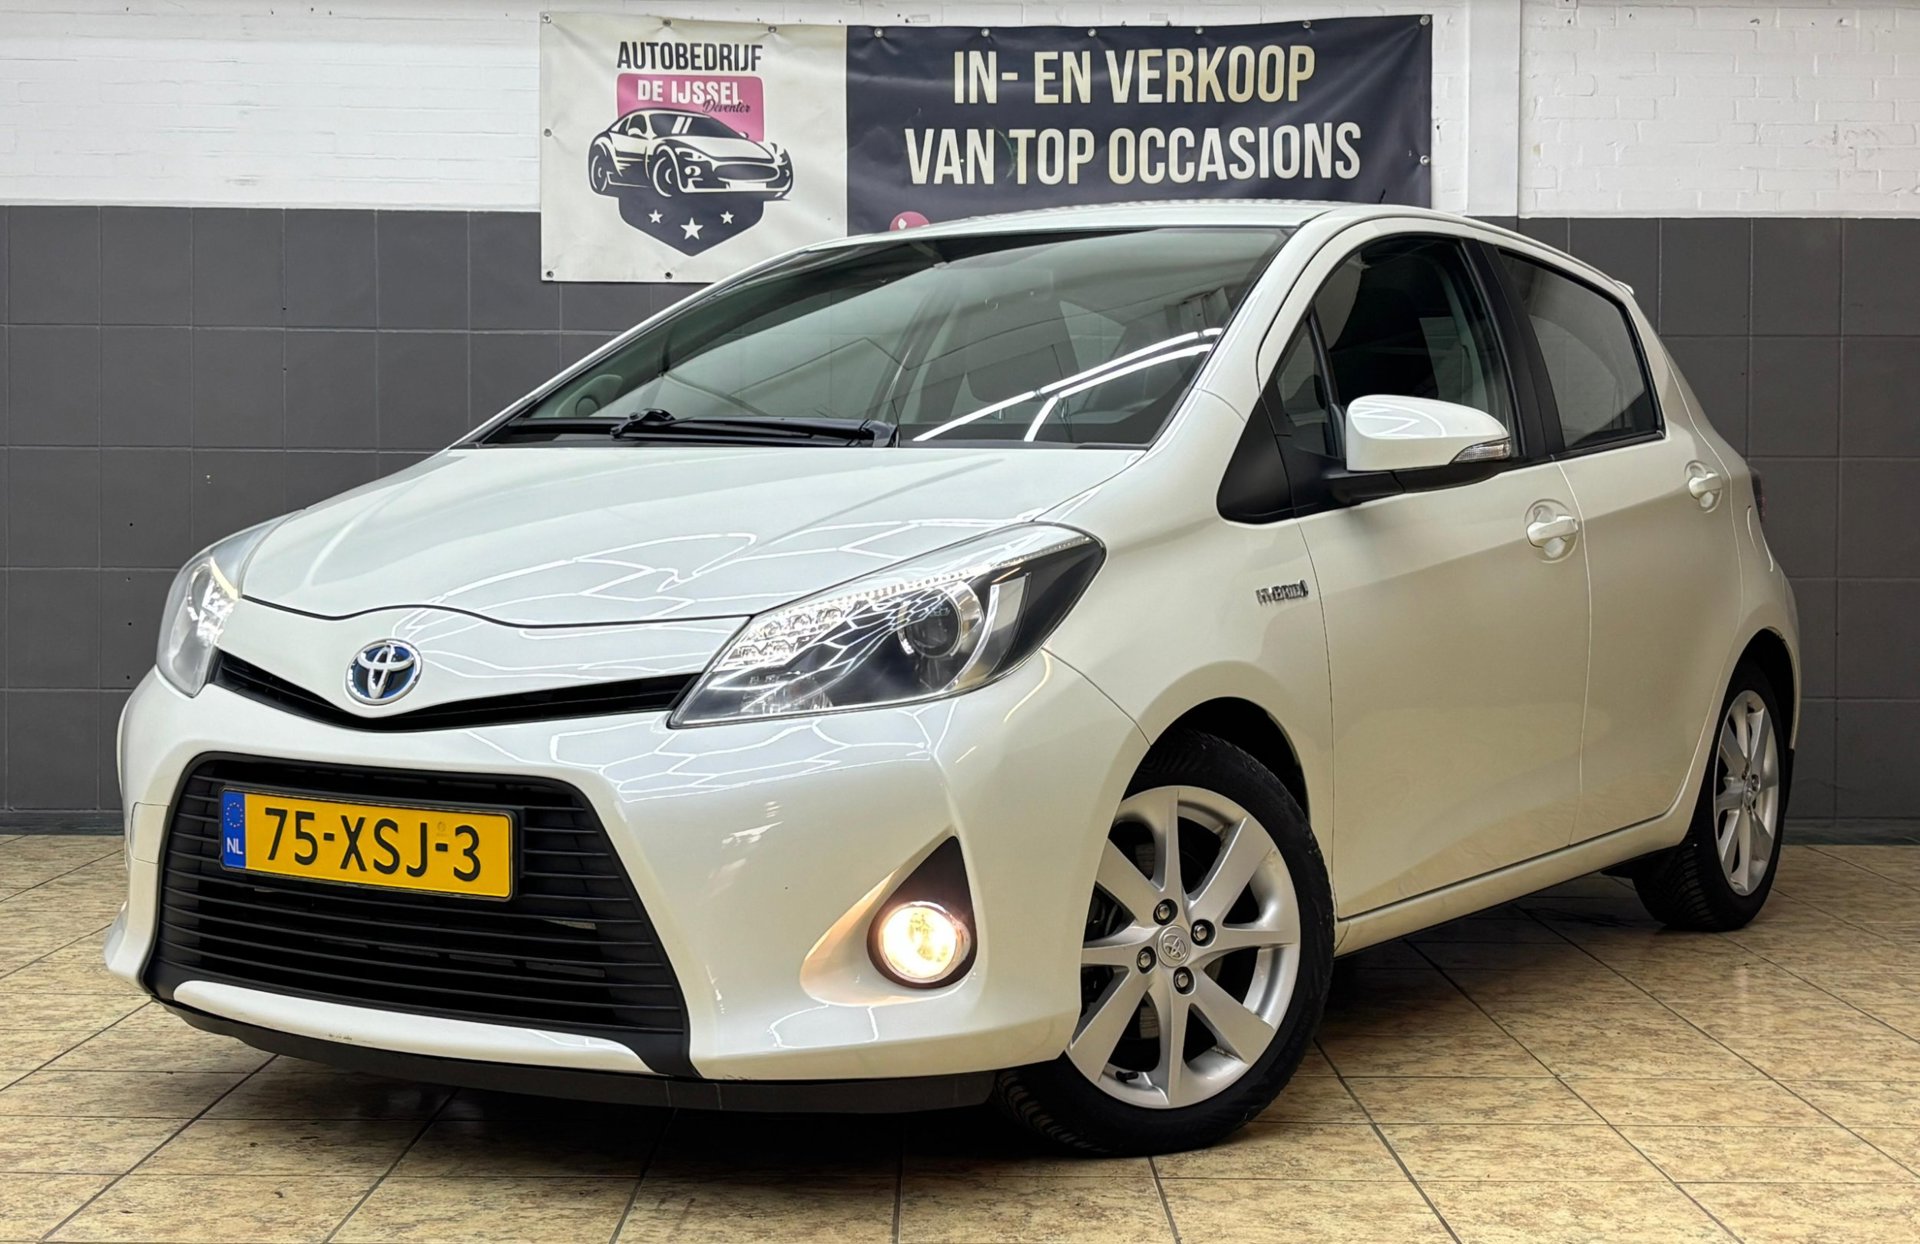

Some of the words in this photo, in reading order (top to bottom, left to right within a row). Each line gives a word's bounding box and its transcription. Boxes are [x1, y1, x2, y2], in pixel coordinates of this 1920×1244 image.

[617, 41, 763, 71] AUTOBEDRIJF
[954, 50, 1018, 104] IN-
[1034, 50, 1091, 104] EN
[1106, 45, 1315, 104] VERKOOP
[637, 79, 664, 102] DE
[671, 80, 743, 105] IJSSEL
[702, 99, 750, 113] Deventer
[904, 128, 994, 186] VAN
[1008, 128, 1095, 186] TOP
[1108, 121, 1361, 185] OCCASIONS
[226, 836, 244, 856] NL
[264, 807, 482, 882] 75-XSJ-3
